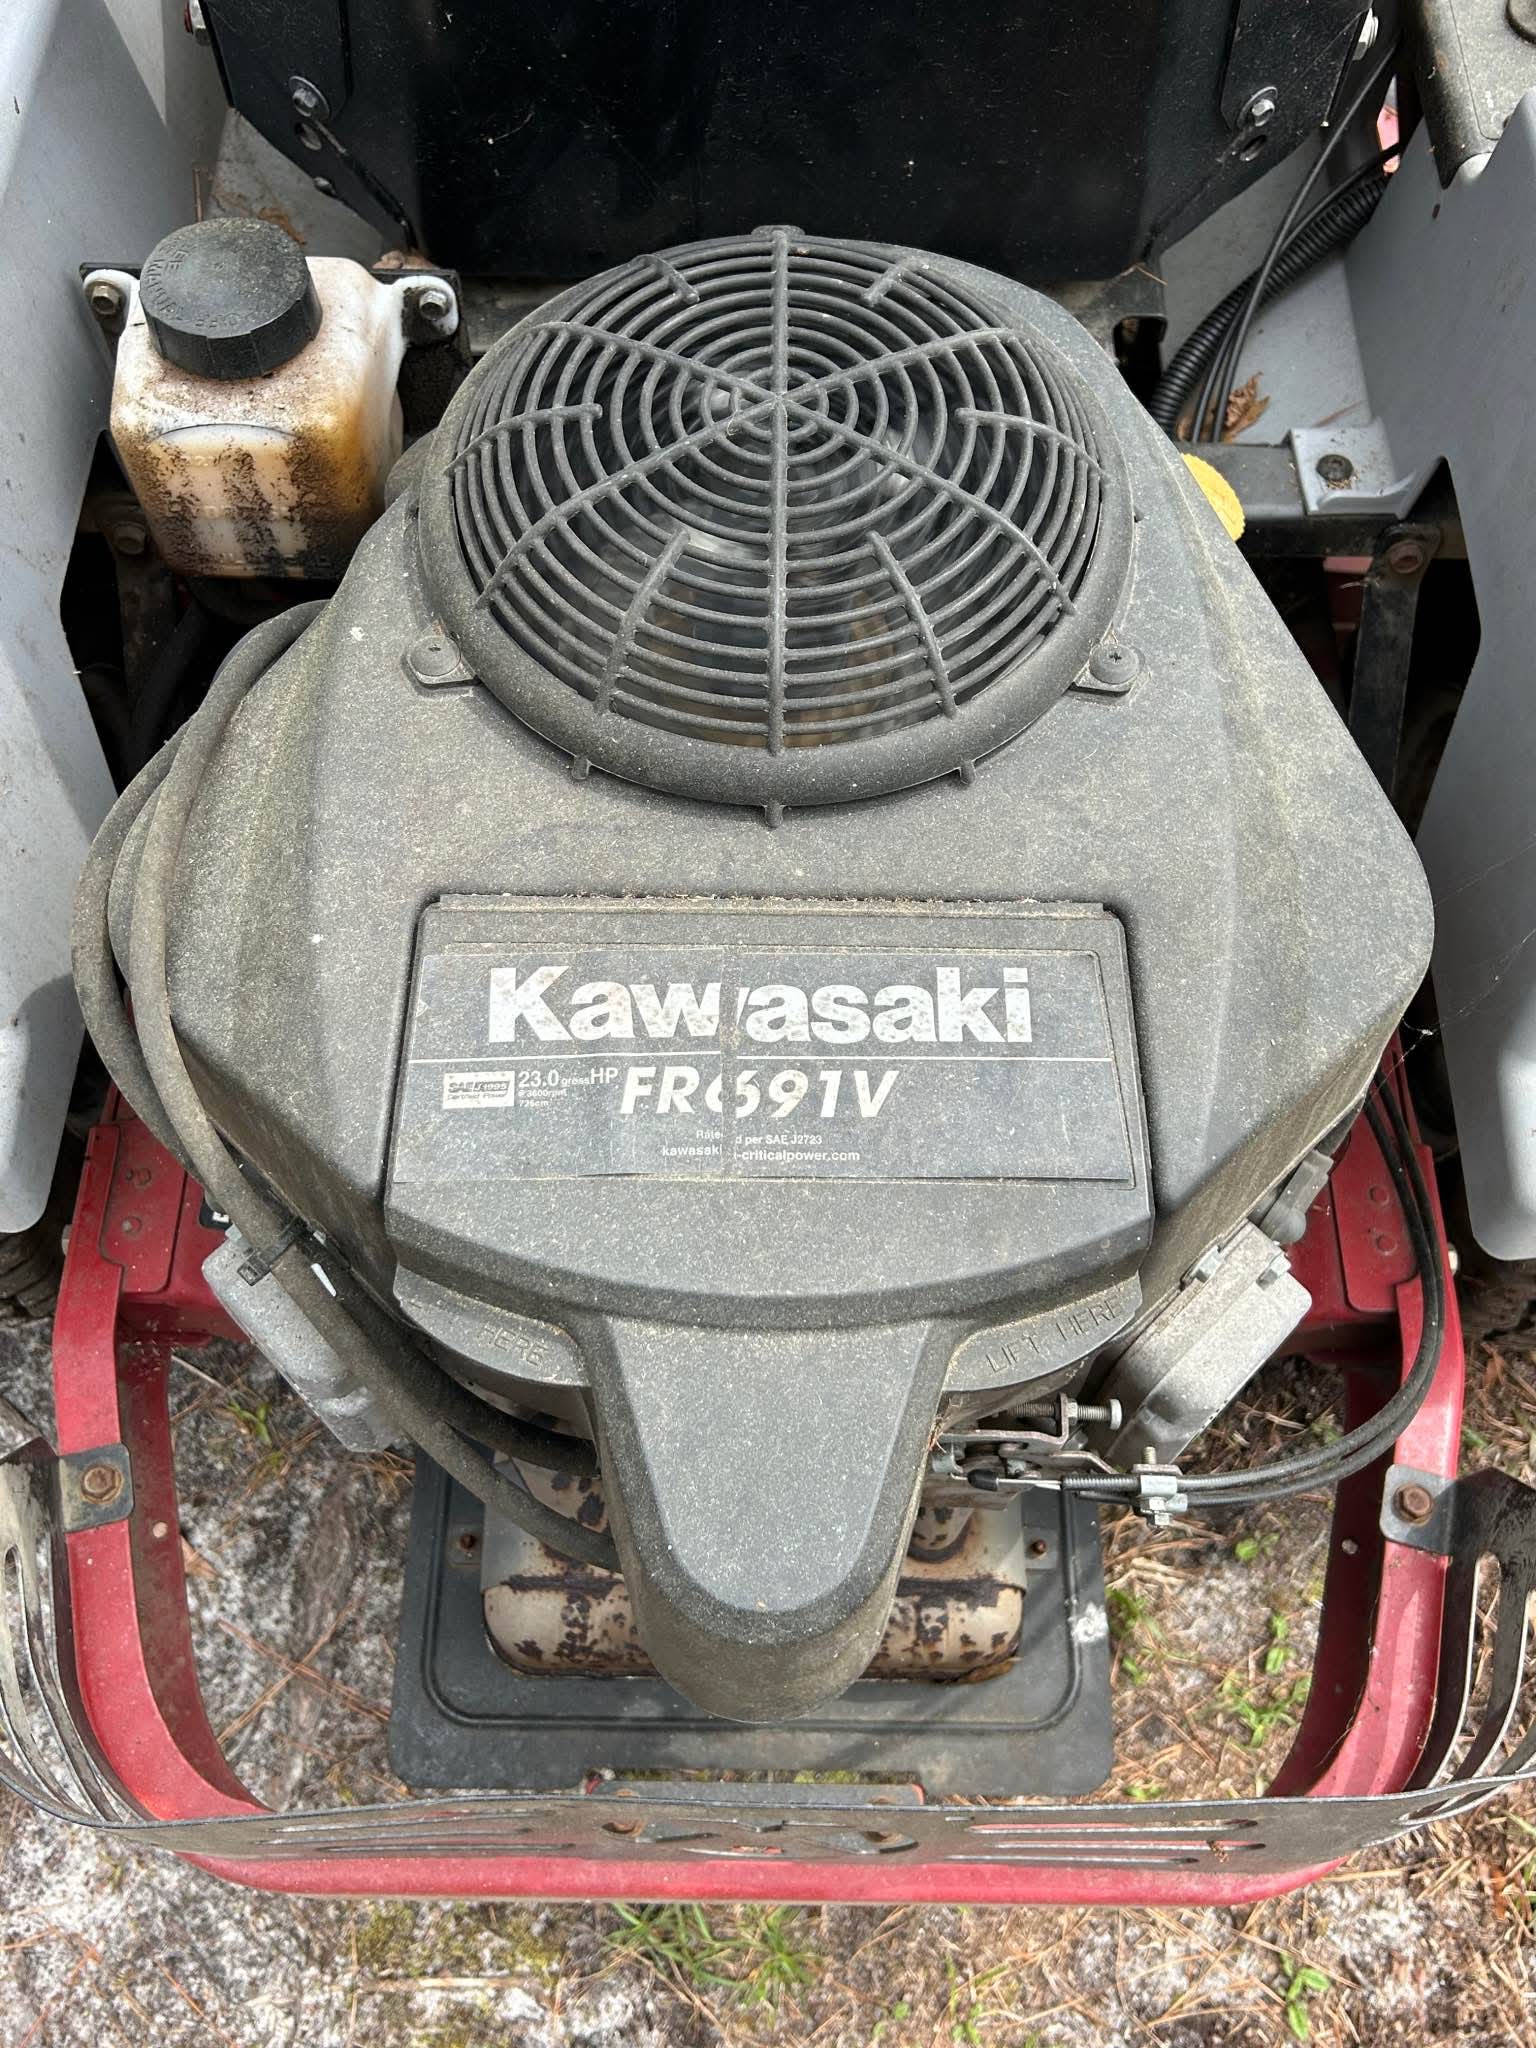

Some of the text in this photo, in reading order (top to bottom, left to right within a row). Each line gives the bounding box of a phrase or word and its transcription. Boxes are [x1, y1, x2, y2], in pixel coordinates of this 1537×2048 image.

[489, 966, 1033, 1043] Kawasaki
[447, 1081, 473, 1093] SAE
[518, 1070, 559, 1088] 23.0
[590, 1066, 618, 1085] HP
[620, 1065, 900, 1119] FR691V
[745, 1137, 763, 1147] per
[765, 1134, 787, 1145] SAE
[790, 1134, 823, 1146] J2723
[986, 1298, 1122, 1374] LIFT HERE
